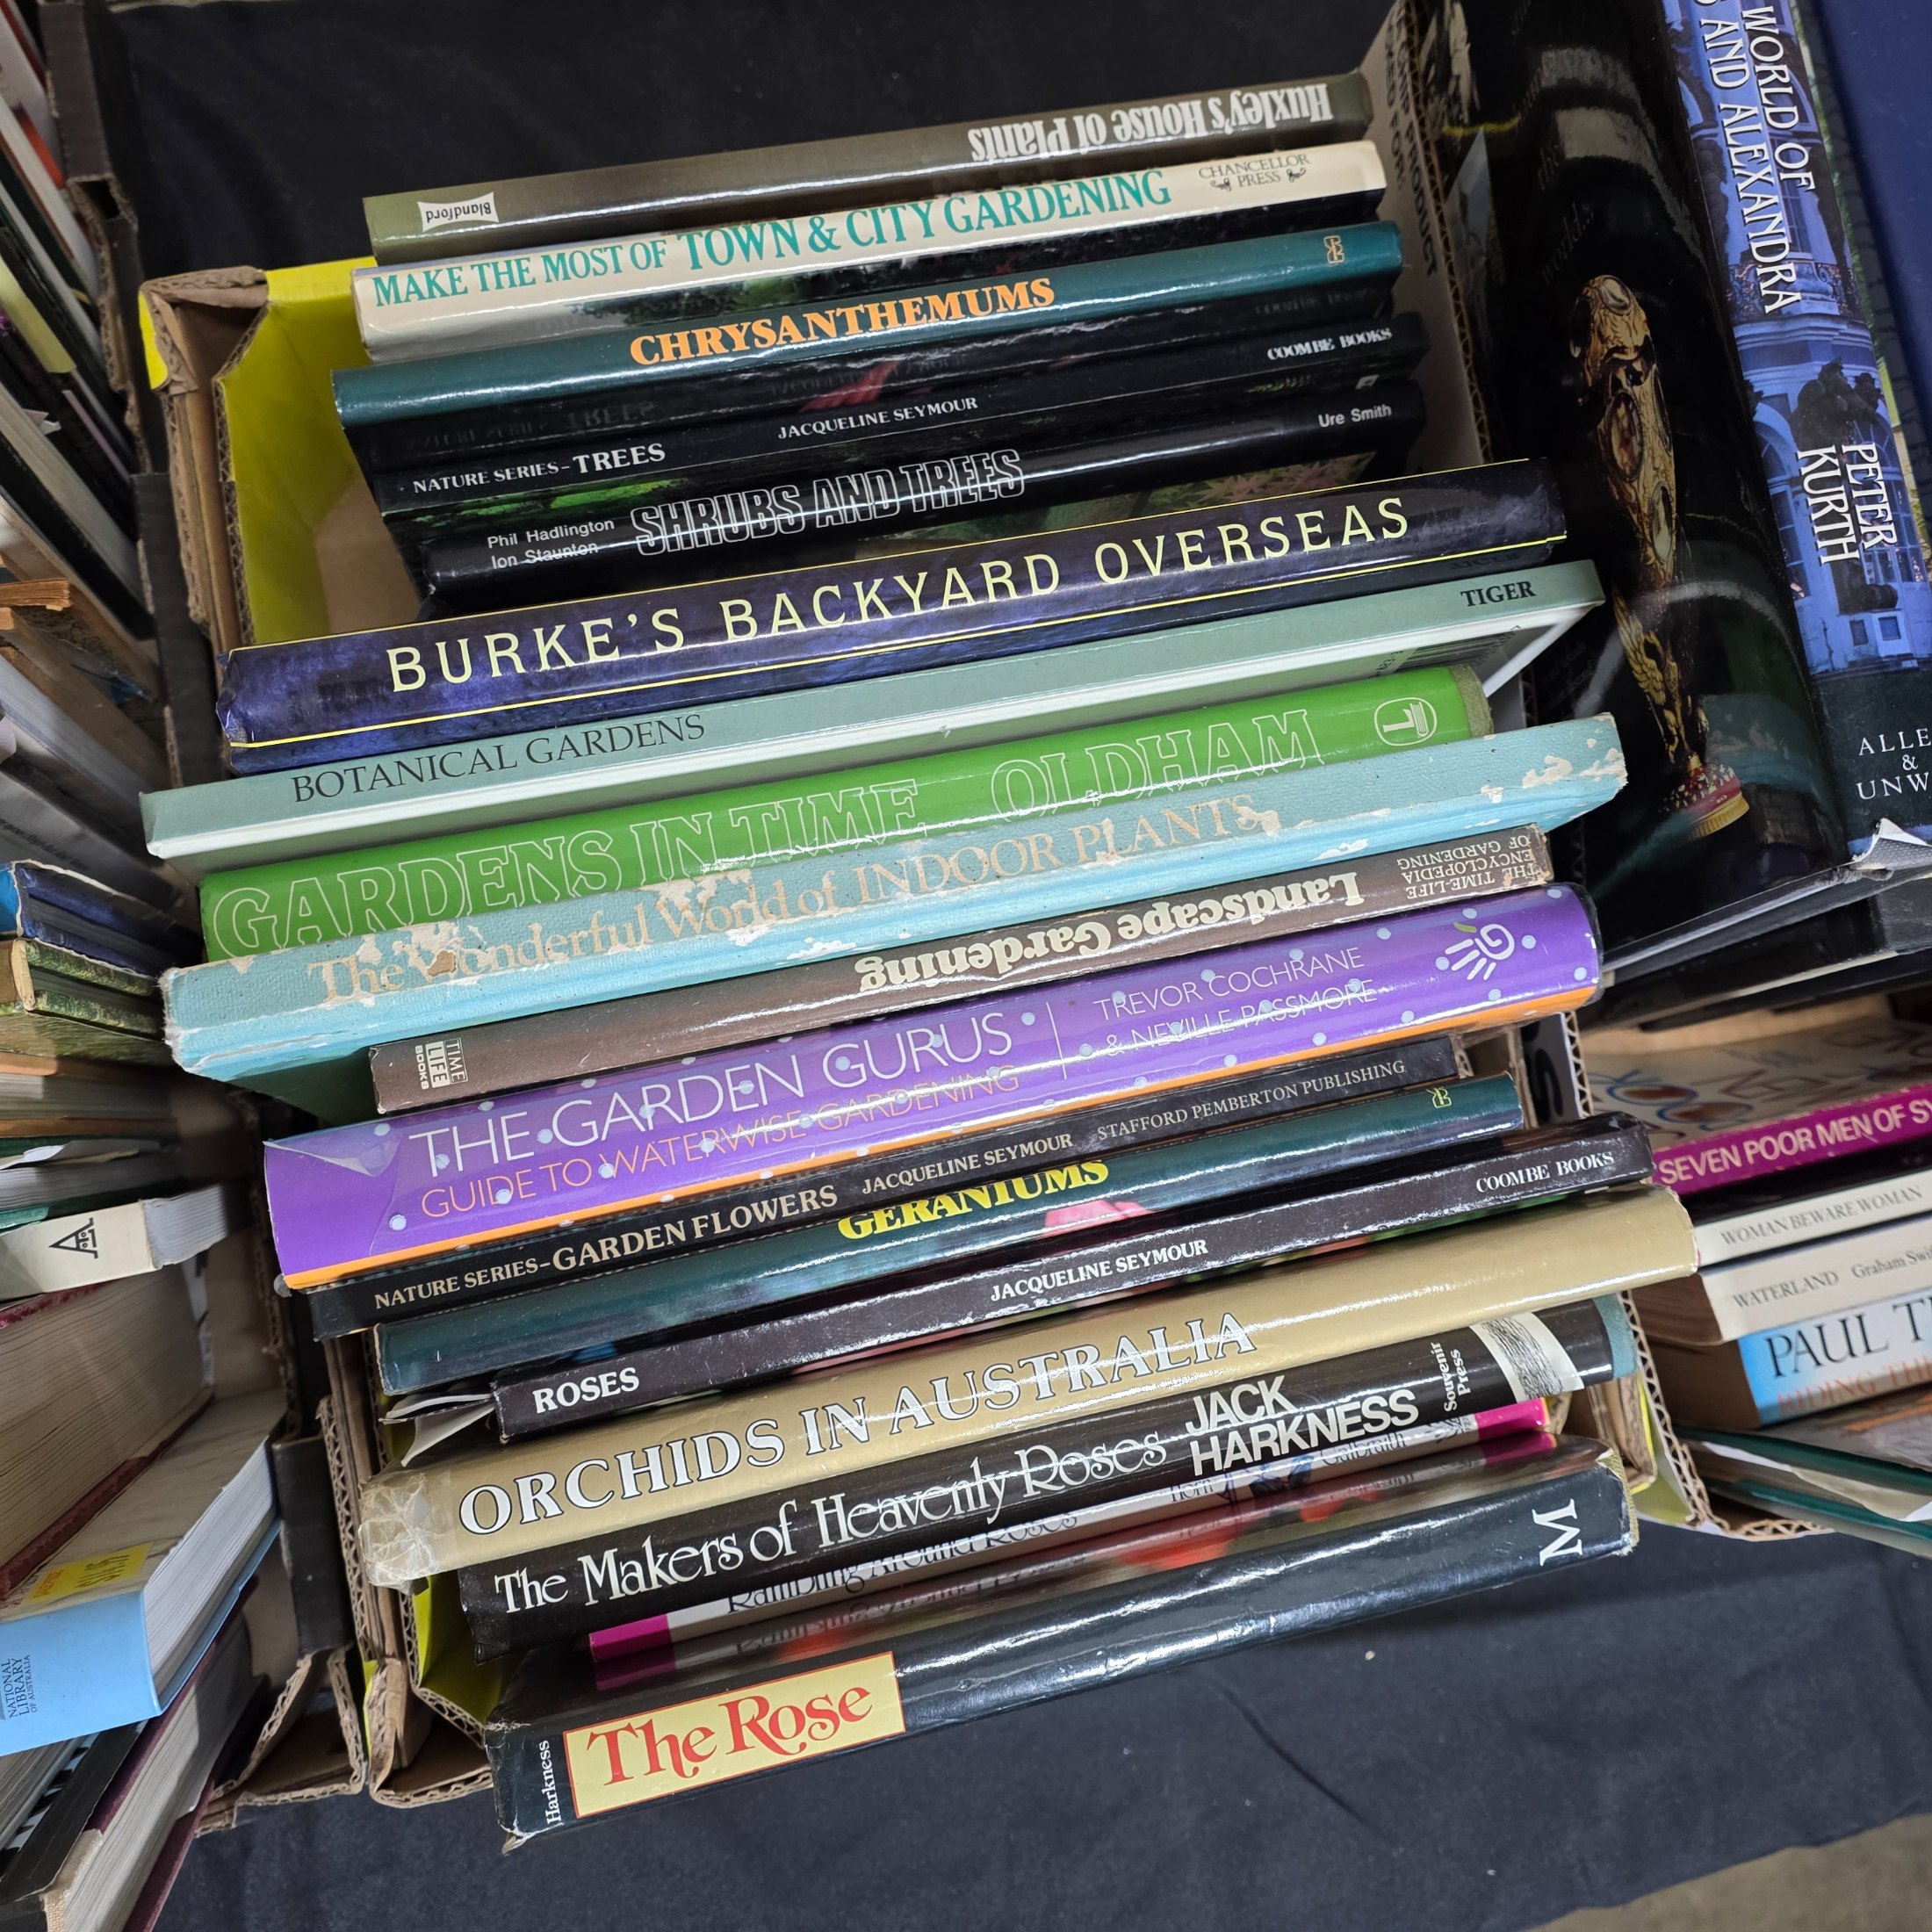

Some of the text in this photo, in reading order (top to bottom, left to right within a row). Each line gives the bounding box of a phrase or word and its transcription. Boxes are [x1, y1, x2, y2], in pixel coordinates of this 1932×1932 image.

[1699, 18, 1750, 89] AND
[968, 83, 1333, 164] Huxley's House of Plants
[1741, 5, 1815, 192] WORLD OF
[1197, 153, 1311, 181] CHANCELLOR
[1237, 170, 1281, 188] PRESS
[373, 171, 1171, 306] MAKE THE MOST OF TOWN & CITY GARDENING
[425, 198, 492, 224] Blandford
[1719, 103, 1801, 314] ALEXANDRA
[630, 277, 1056, 365] CHRYSANTHEMUMS
[413, 470, 489, 494] NATURE
[778, 410, 890, 439] JACQUELINE
[892, 396, 978, 423] SEYMOUR
[1267, 336, 1334, 361] COOMBE
[1339, 328, 1392, 350] BOOKS
[1319, 402, 1392, 429] Ure Smith
[487, 518, 616, 549] Phil Hadlington
[631, 449, 1027, 557] SHRUBS AND TREES
[1795, 445, 1859, 566] KURTH
[1842, 443, 1898, 550] PETER
[491, 539, 599, 570] Ion Staunton
[386, 497, 1409, 693] BURKE'S BACKYARD OVERSEAS
[291, 580, 1536, 803] BOTANICAL GARDENS TIGER
[1901, 753, 1918, 771] &
[213, 830, 624, 958] GARDENS
[630, 811, 724, 887] IN
[728, 776, 928, 872] TIME
[990, 710, 1327, 823] OLDHAM
[1396, 835, 1531, 870] OF GARDENING
[1402, 849, 1536, 884] ENCYCLOPEDIA
[307, 958, 405, 1005] The
[656, 879, 789, 937] World
[797, 870, 837, 917] of
[853, 833, 1068, 905] INDOOR
[1070, 793, 1262, 865] PLANTS
[1405, 871, 1495, 899] TIME-LIFE
[856, 870, 1365, 994] Landscape Gardening
[1093, 948, 1366, 1022] TREVOR COCHRANE
[1107, 980, 1379, 1056] & NEVILLE PASSMORE
[409, 1012, 1013, 1179] THE GARDEN GURUS
[415, 1045, 429, 1090] BOOKS
[428, 1046, 448, 1083] LIFE
[446, 1040, 466, 1082] TIME
[422, 1064, 1020, 1219] GUIDE TO WATERWISE GARDENING
[1657, 1147, 1741, 1187] SEVEN
[1743, 1127, 1816, 1164] POOR
[1815, 1114, 1873, 1147] MEN
[1872, 1103, 1907, 1133] OF
[374, 1275, 458, 1308] NATURE
[691, 1185, 839, 1239] FLOWERS
[861, 1154, 978, 1195] JACQUELINE
[984, 1132, 1074, 1169] SEYMOUR
[1097, 1106, 1188, 1140] STAFFORD
[1191, 1086, 1301, 1124] PEMBERTON
[1302, 1060, 1406, 1098] PUBLISHING
[837, 1157, 1109, 1241] GERANIUMS
[1720, 1185, 1923, 1246] WOMAN BEWARE WOMAN
[532, 1150, 1614, 1415] ROSES JACQUELINE SEYMOUR COOMBE BOOKS
[1733, 1270, 1840, 1309] WATERLAND
[1850, 1258, 1907, 1279] Graham
[1430, 1342, 1459, 1411] Souvenir
[1449, 1348, 1470, 1396] Press
[1764, 1312, 1889, 1379] PAUL
[458, 1312, 1258, 1536] ORCHIDS IN AUSTRALIA
[1186, 1375, 1299, 1437] JACK
[1190, 1389, 1419, 1476] HARKNESS
[1777, 1372, 1878, 1417] RIDING
[494, 1430, 1168, 1614] The Makers of Heavenly Roses
[2, 1658, 18, 1719] NATIONAL
[11, 1657, 30, 1717] LIBRARY
[23, 1654, 38, 1713] OF AUSTRALIA
[588, 1682, 873, 1786] The Rose
[537, 1739, 566, 1826] Harkness
